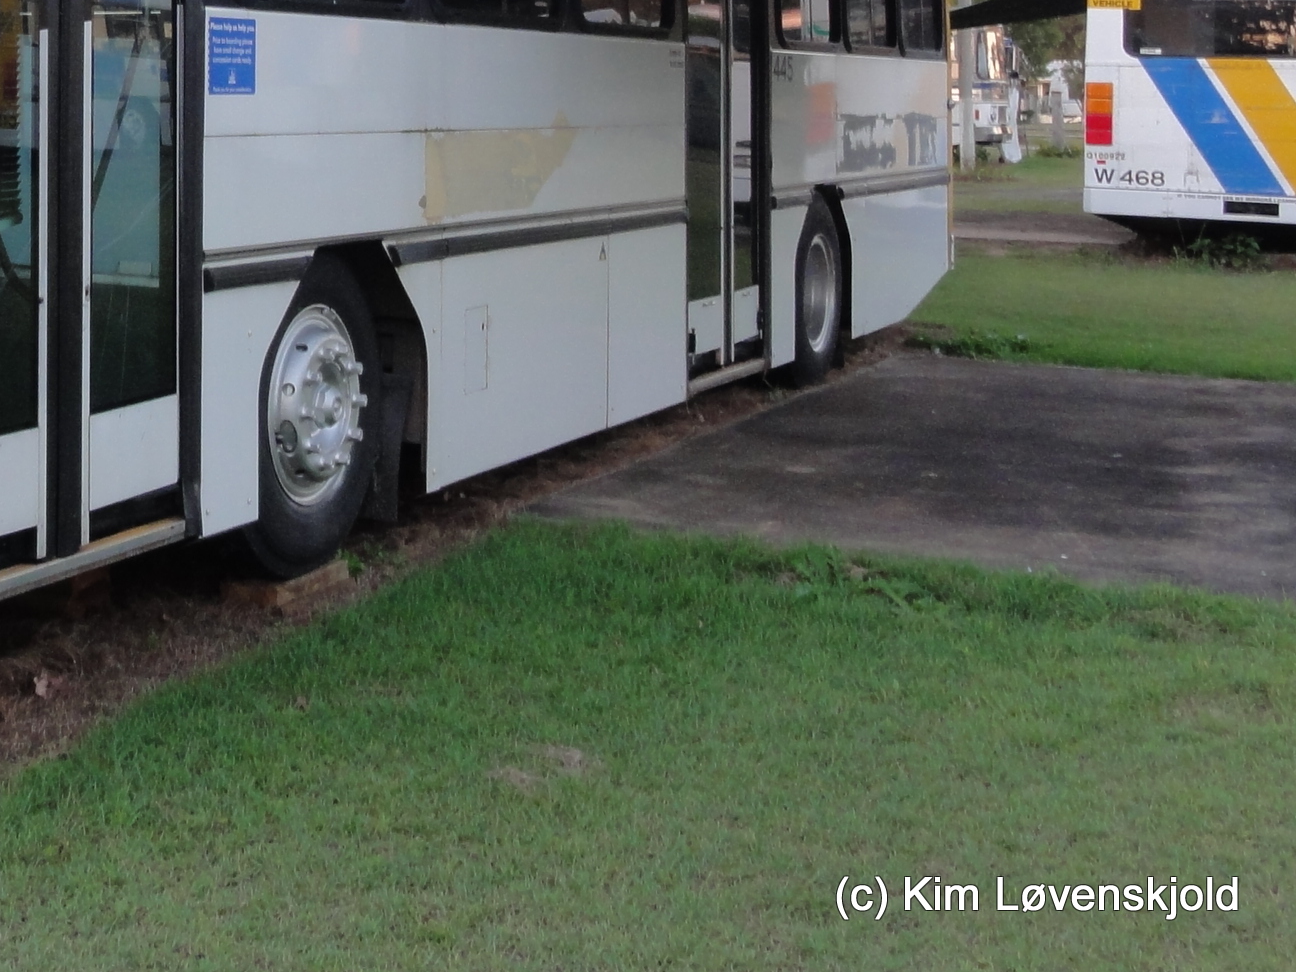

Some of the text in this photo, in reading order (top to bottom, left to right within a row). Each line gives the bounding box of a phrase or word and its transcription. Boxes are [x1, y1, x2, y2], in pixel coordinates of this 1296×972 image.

[773, 55, 794, 83] 445
[1094, 167, 1166, 187] W 468
